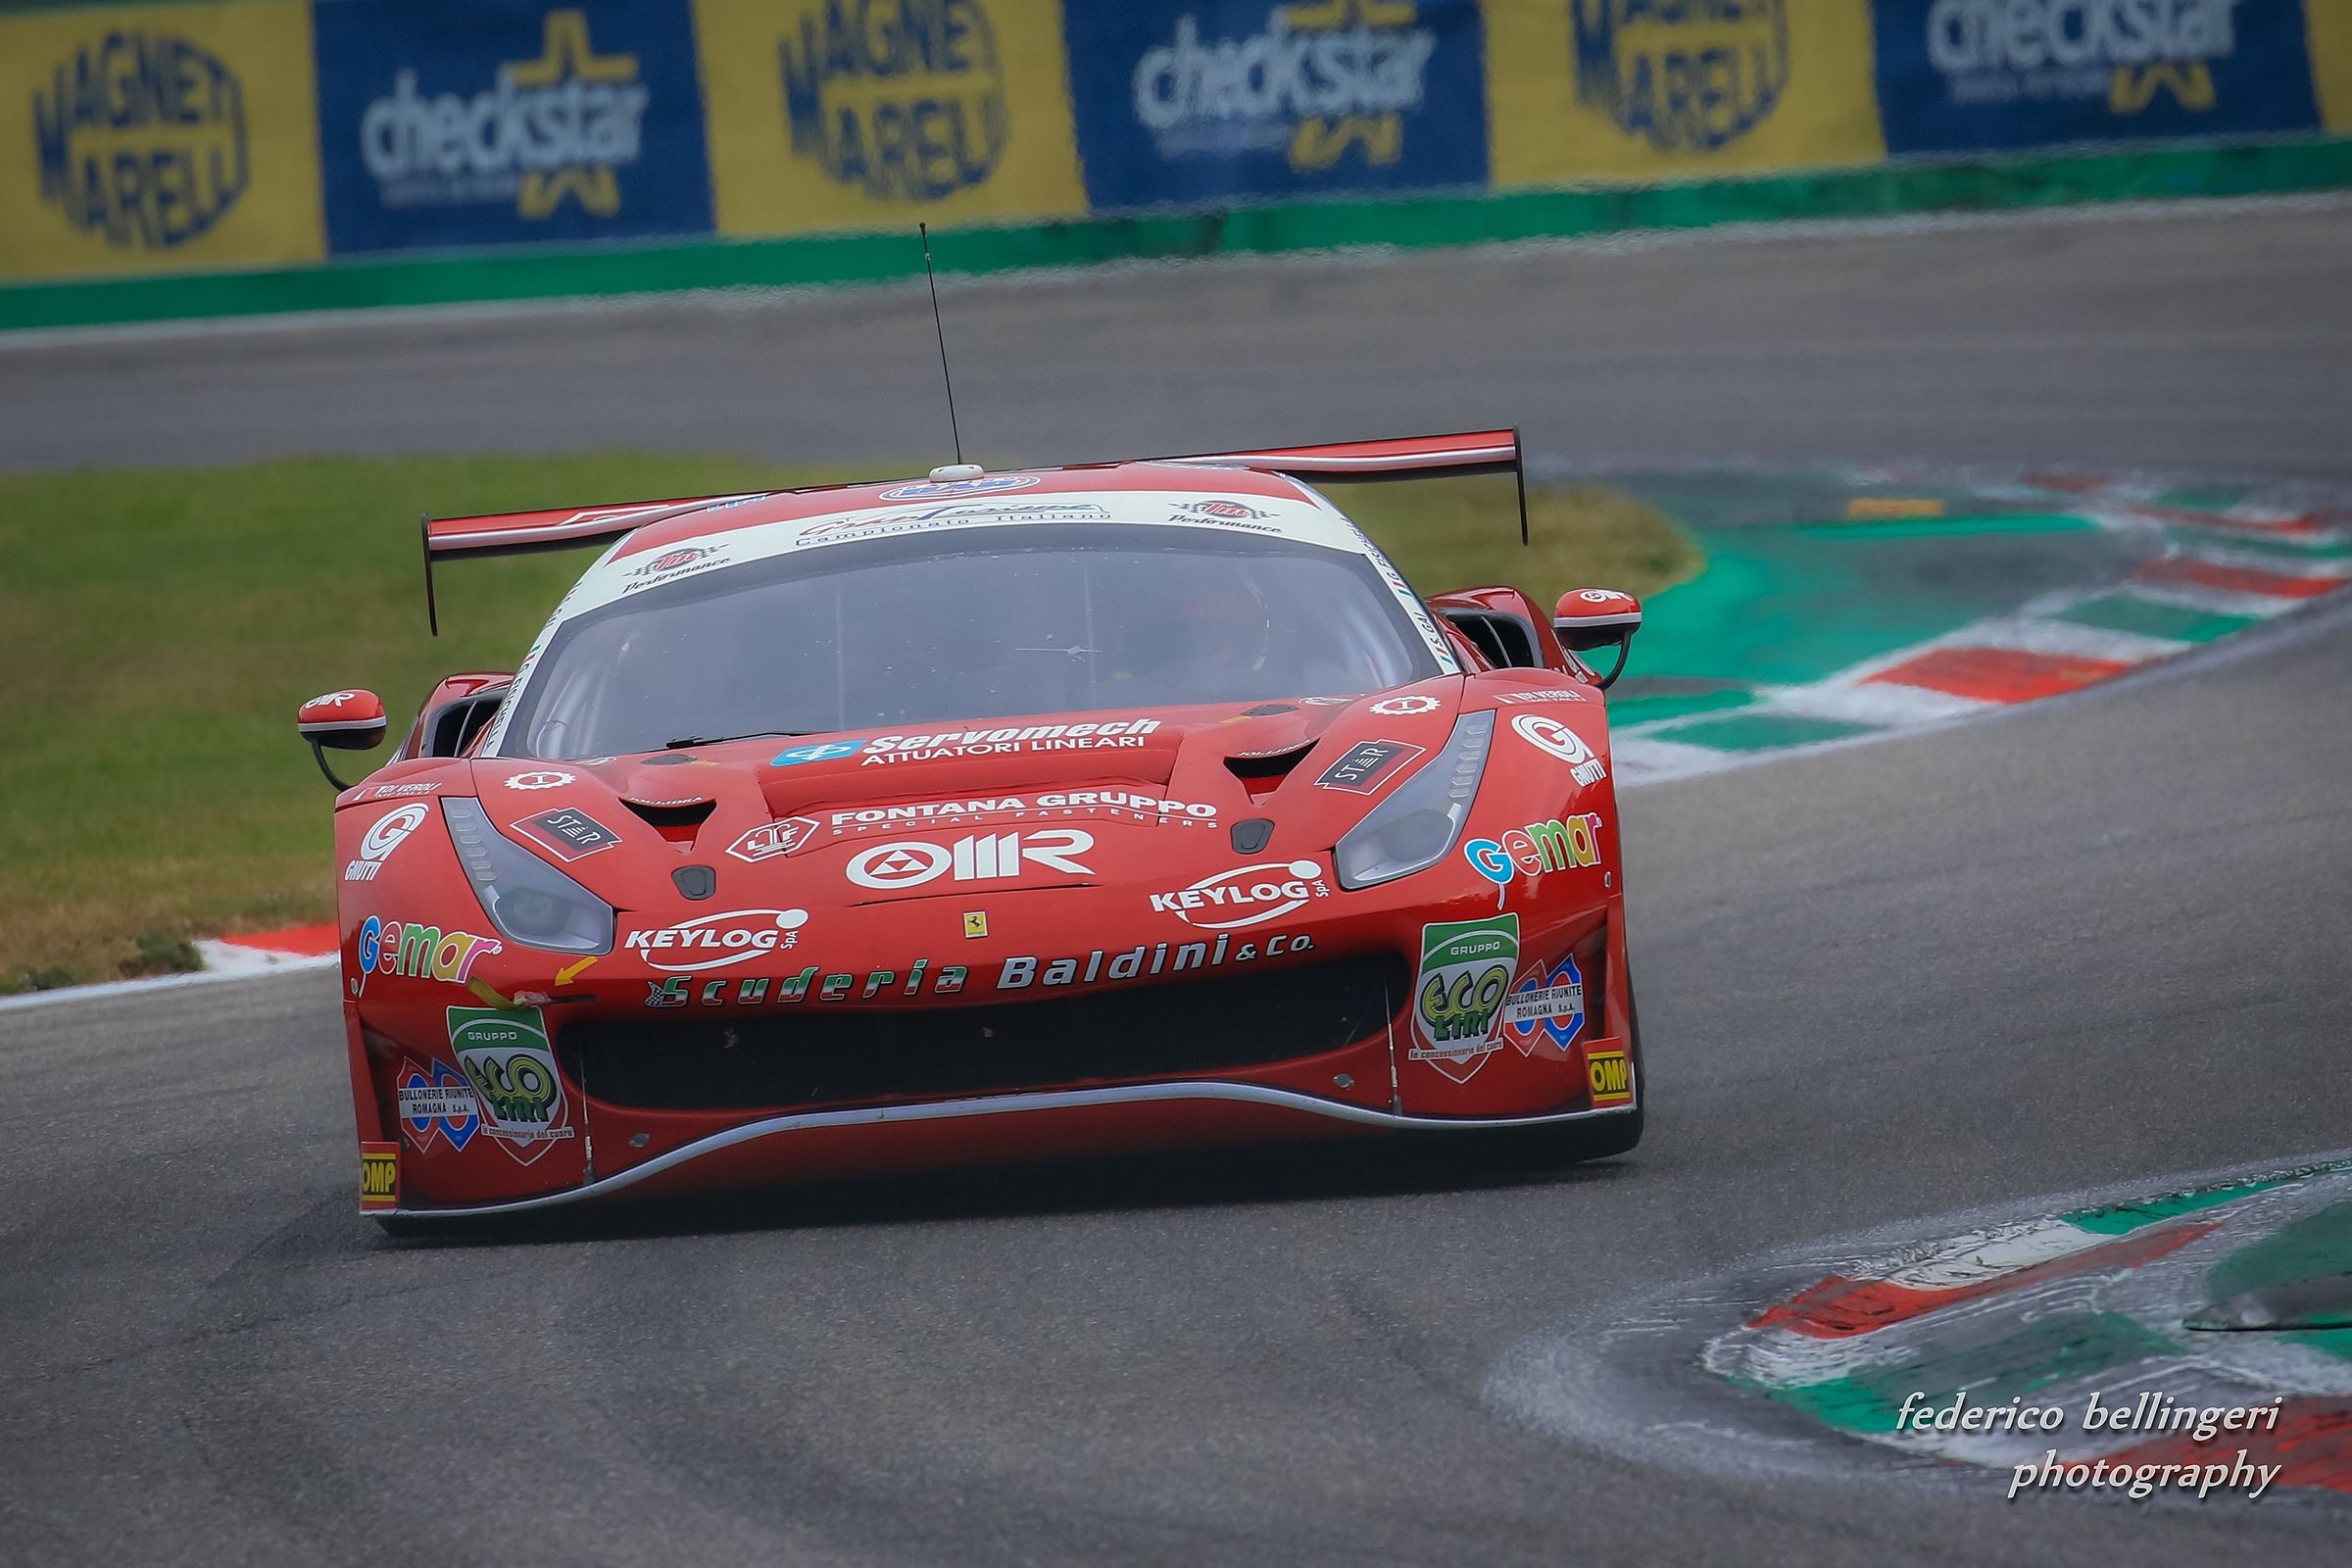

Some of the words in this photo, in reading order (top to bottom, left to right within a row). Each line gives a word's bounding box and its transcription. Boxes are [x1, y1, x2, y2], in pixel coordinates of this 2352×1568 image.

[361, 67, 649, 179] checkstar
[795, 519, 970, 547] Campionato
[996, 513, 1112, 522] Italiano
[1168, 514, 1283, 534] Performance
[621, 557, 731, 595] Performance
[1413, 612, 1436, 634] GAI
[860, 741, 1020, 766] ATTUATORI
[1032, 735, 1146, 752] LINEARI
[862, 718, 1162, 754] Servomech
[832, 797, 1026, 825] FONTANA
[1036, 790, 1218, 818] GRUPPO
[832, 814, 984, 835] SPECIAL
[1015, 807, 1218, 829] FASTENERS
[1463, 811, 1603, 884] Gemar
[1148, 880, 1311, 912] KEYLOG
[358, 914, 503, 984] Gemar
[623, 928, 780, 949] KEYLOG
[1450, 941, 1501, 956] GRUPPO
[645, 956, 969, 1007] Scuderia
[995, 932, 1231, 991] Baldini
[1234, 942, 1257, 962] &
[1264, 934, 1315, 956] Co.
[1420, 963, 1509, 1029] ECO
[1506, 990, 1549, 1006] BULLONERIE
[1550, 984, 1582, 1001] RIUNITE
[1516, 1003, 1553, 1018] ROMAGNA
[467, 1031, 517, 1041] GRUPPO
[1590, 1058, 1629, 1092] OMP
[399, 1088, 443, 1101] BULLONERIE
[445, 1088, 475, 1100] RIUNITE
[412, 1102, 447, 1113] ROMAGNA
[362, 1161, 396, 1193] OMP
